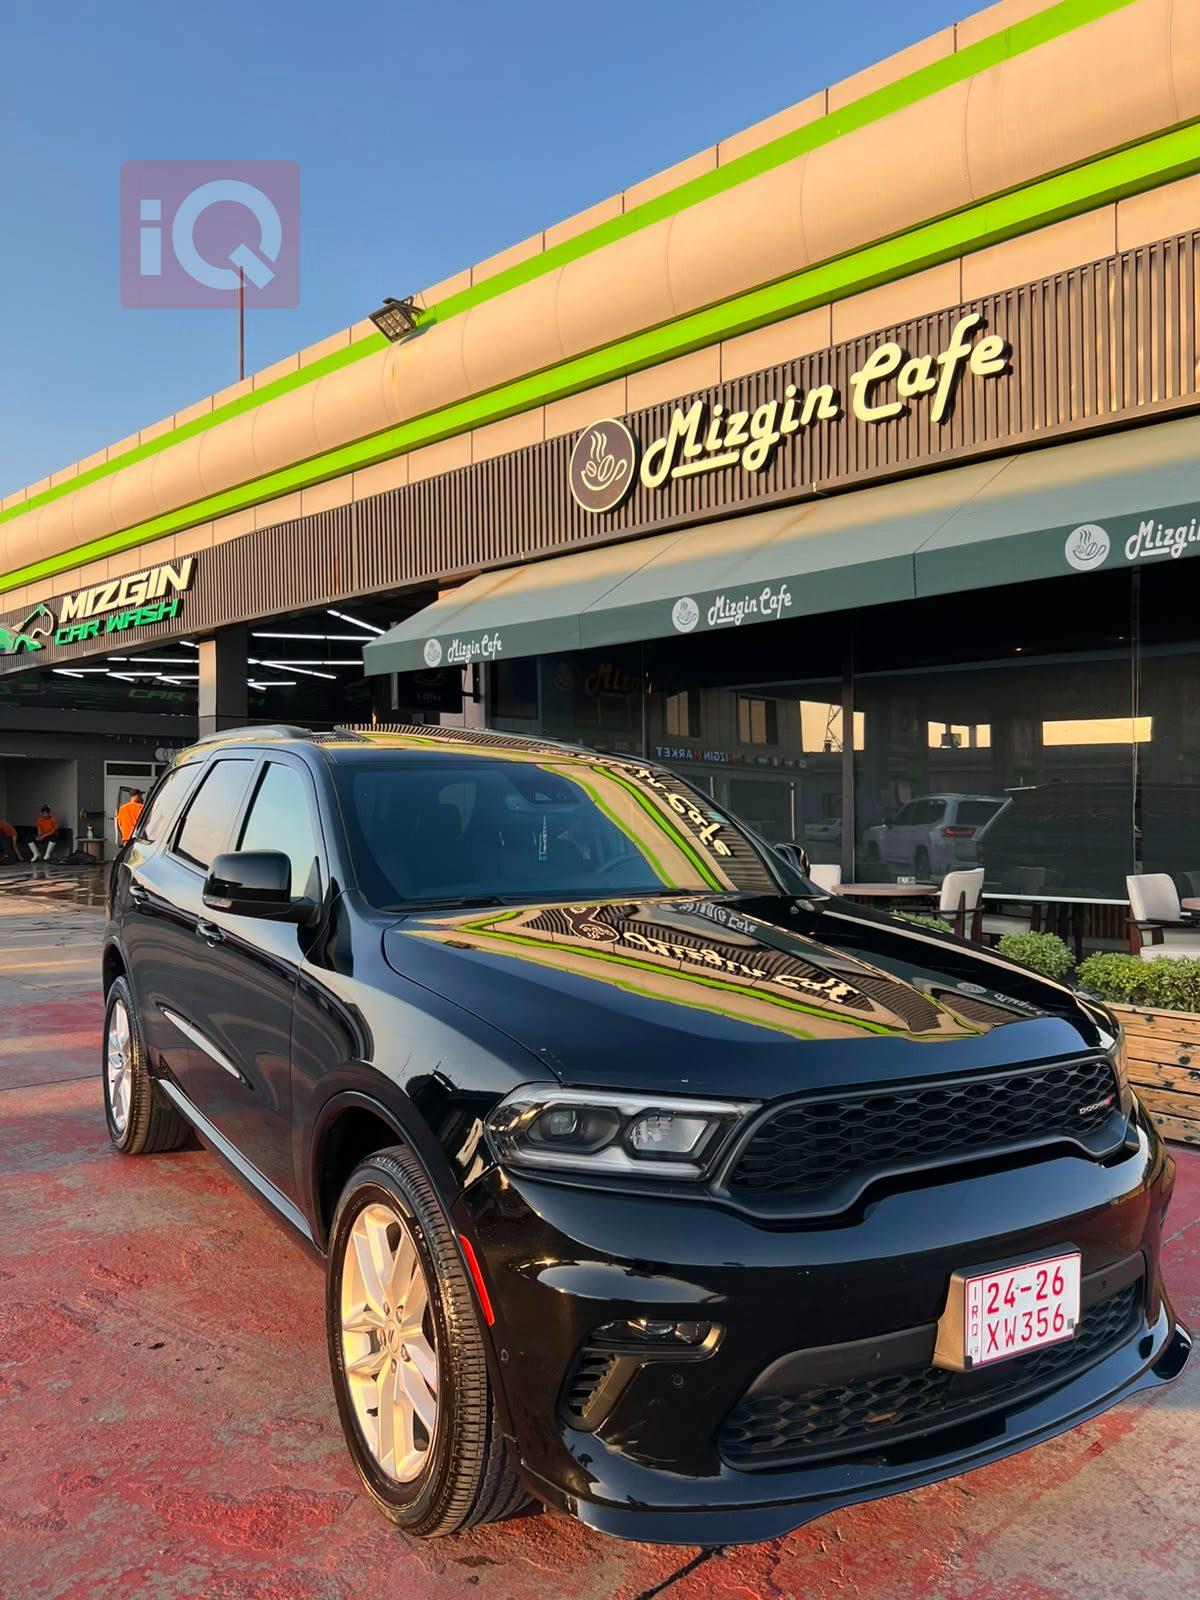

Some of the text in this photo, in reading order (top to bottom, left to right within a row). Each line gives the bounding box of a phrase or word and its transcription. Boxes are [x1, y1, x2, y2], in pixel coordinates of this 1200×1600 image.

[640, 312, 1008, 488] Mizgin Cafe
[1125, 518, 1200, 560] Mizgi
[59, 557, 197, 623] MIZGIN
[708, 584, 792, 626] Mizgin Cafe
[54, 599, 182, 646] CAR WASH
[447, 632, 502, 663] Mizgin Cafe
[986, 1265, 1065, 1315] 24-26
[986, 1302, 1065, 1354] XW356
